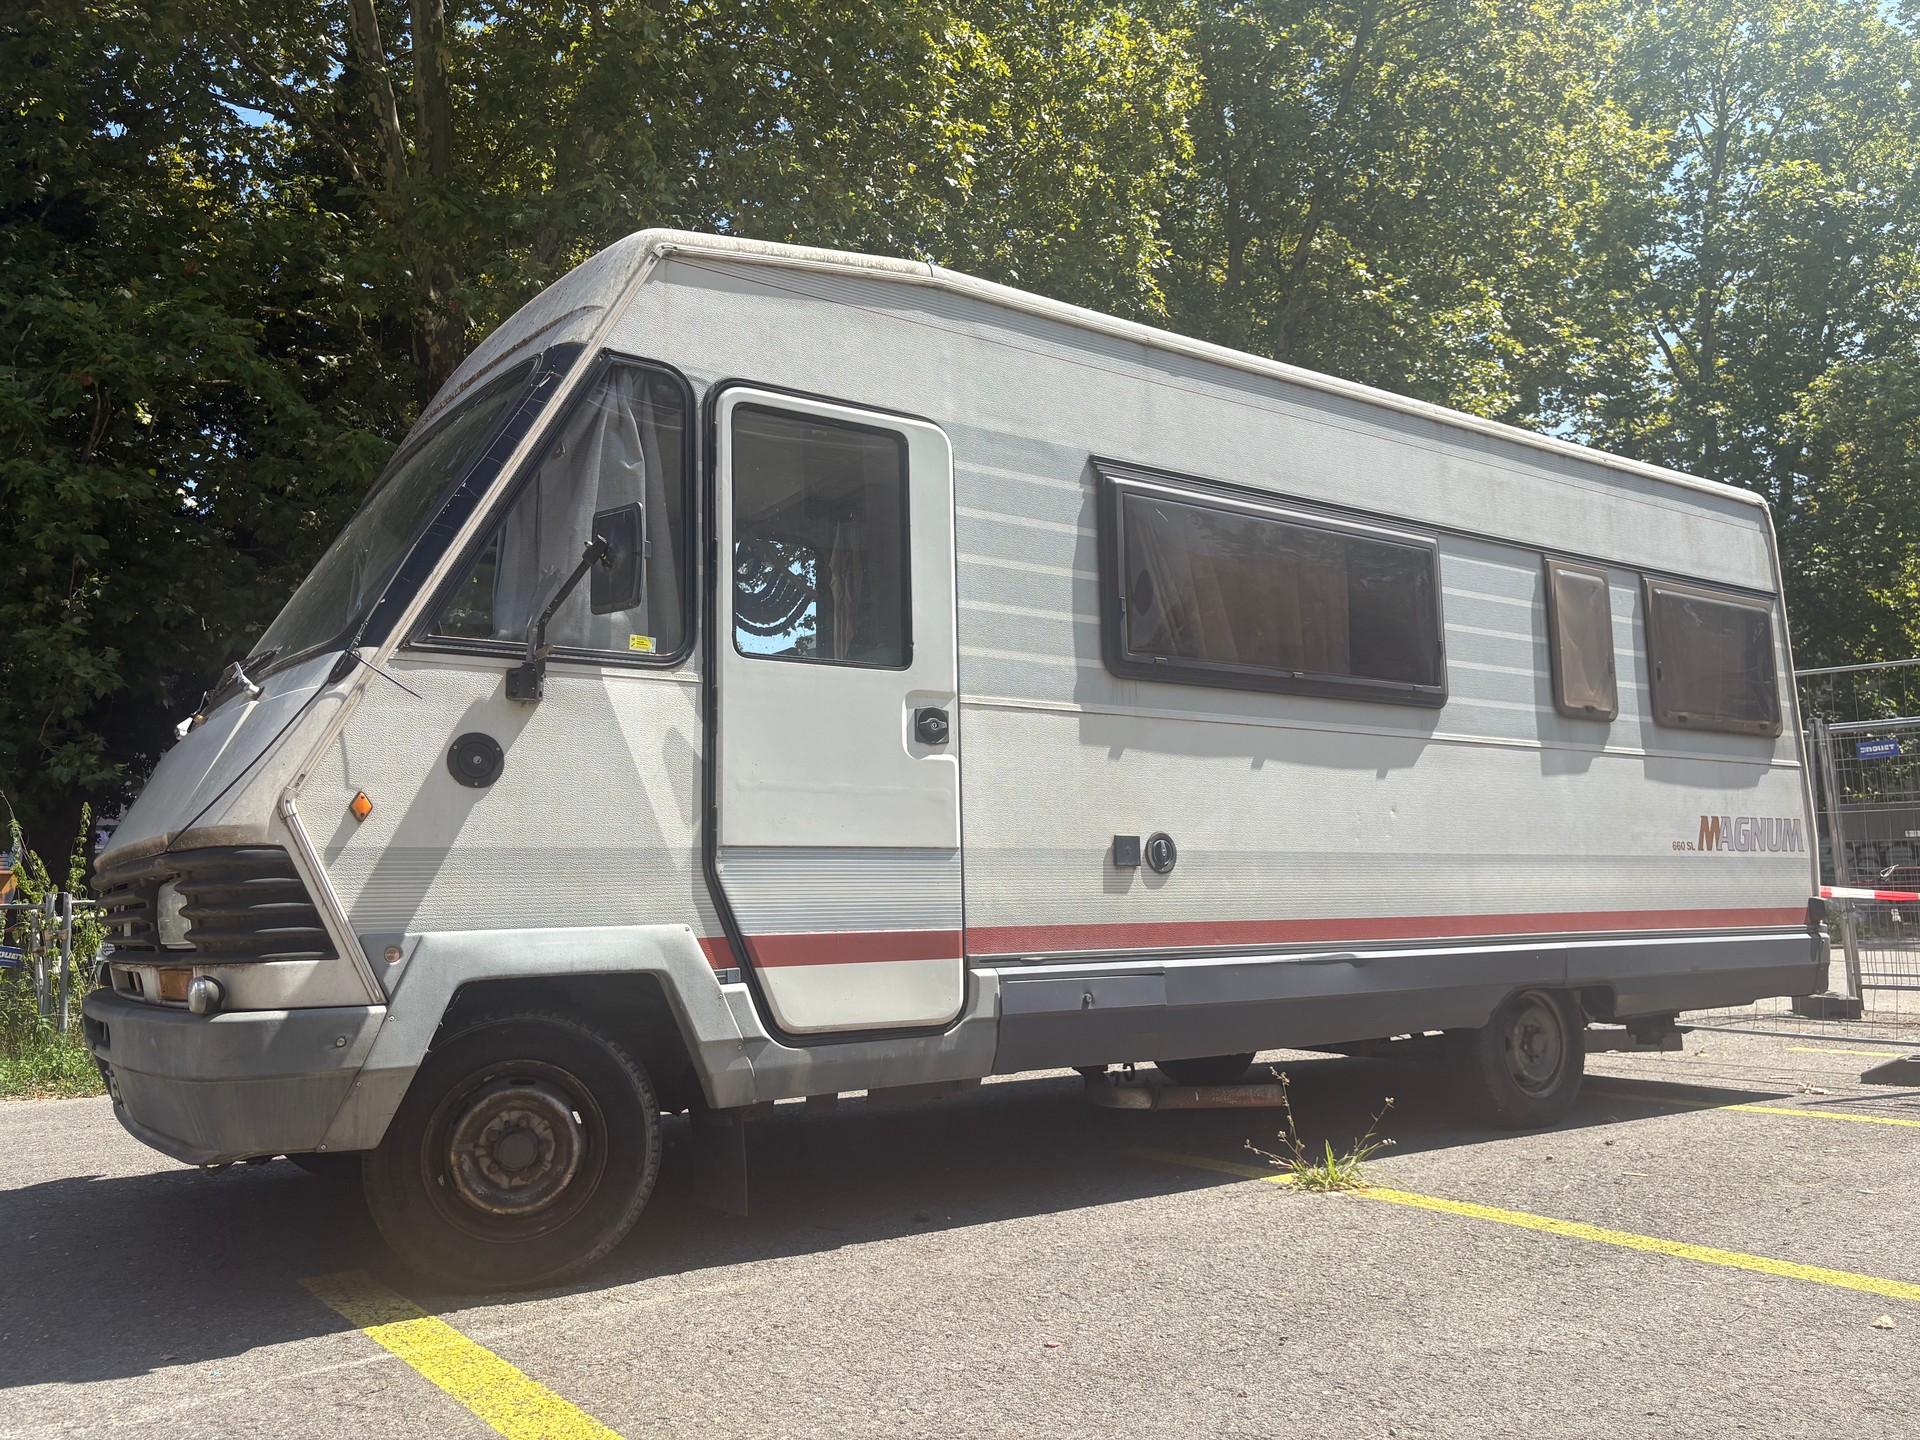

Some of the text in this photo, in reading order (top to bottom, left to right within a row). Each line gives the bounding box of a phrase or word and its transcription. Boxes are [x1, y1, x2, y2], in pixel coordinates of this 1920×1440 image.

[1672, 815, 1805, 852] 660 SL MAGNUM
